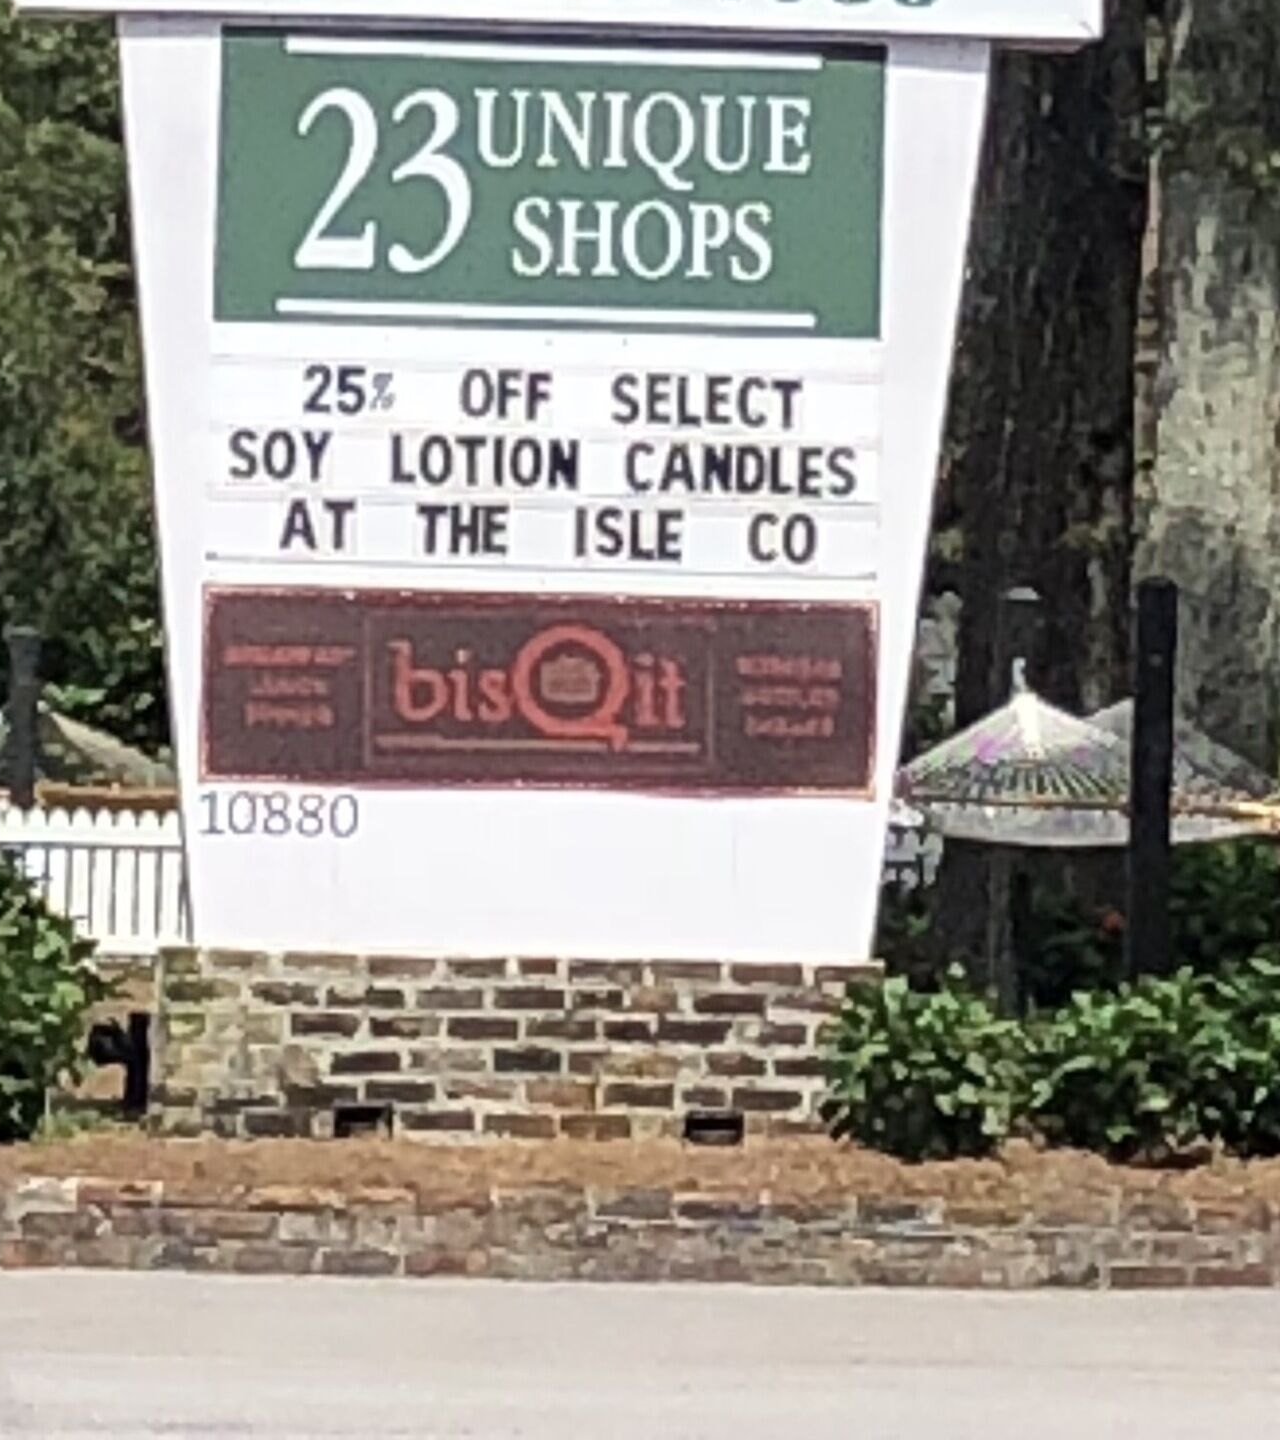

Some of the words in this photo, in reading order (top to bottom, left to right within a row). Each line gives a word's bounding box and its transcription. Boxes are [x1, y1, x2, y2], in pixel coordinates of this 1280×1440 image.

[295, 88, 472, 273] 23
[475, 89, 812, 190] UNIQUE
[511, 196, 773, 282] SHOPS
[303, 366, 396, 416] 25%
[460, 370, 552, 420] OFF
[611, 374, 804, 428] SELECT
[228, 431, 333, 480] SOY
[392, 436, 579, 492] LOTION
[625, 442, 858, 500] CANDLES
[279, 500, 357, 551] AT
[417, 505, 509, 555] THE
[576, 509, 684, 560] ISLE
[748, 513, 817, 562] CO
[199, 791, 359, 838] 10880
